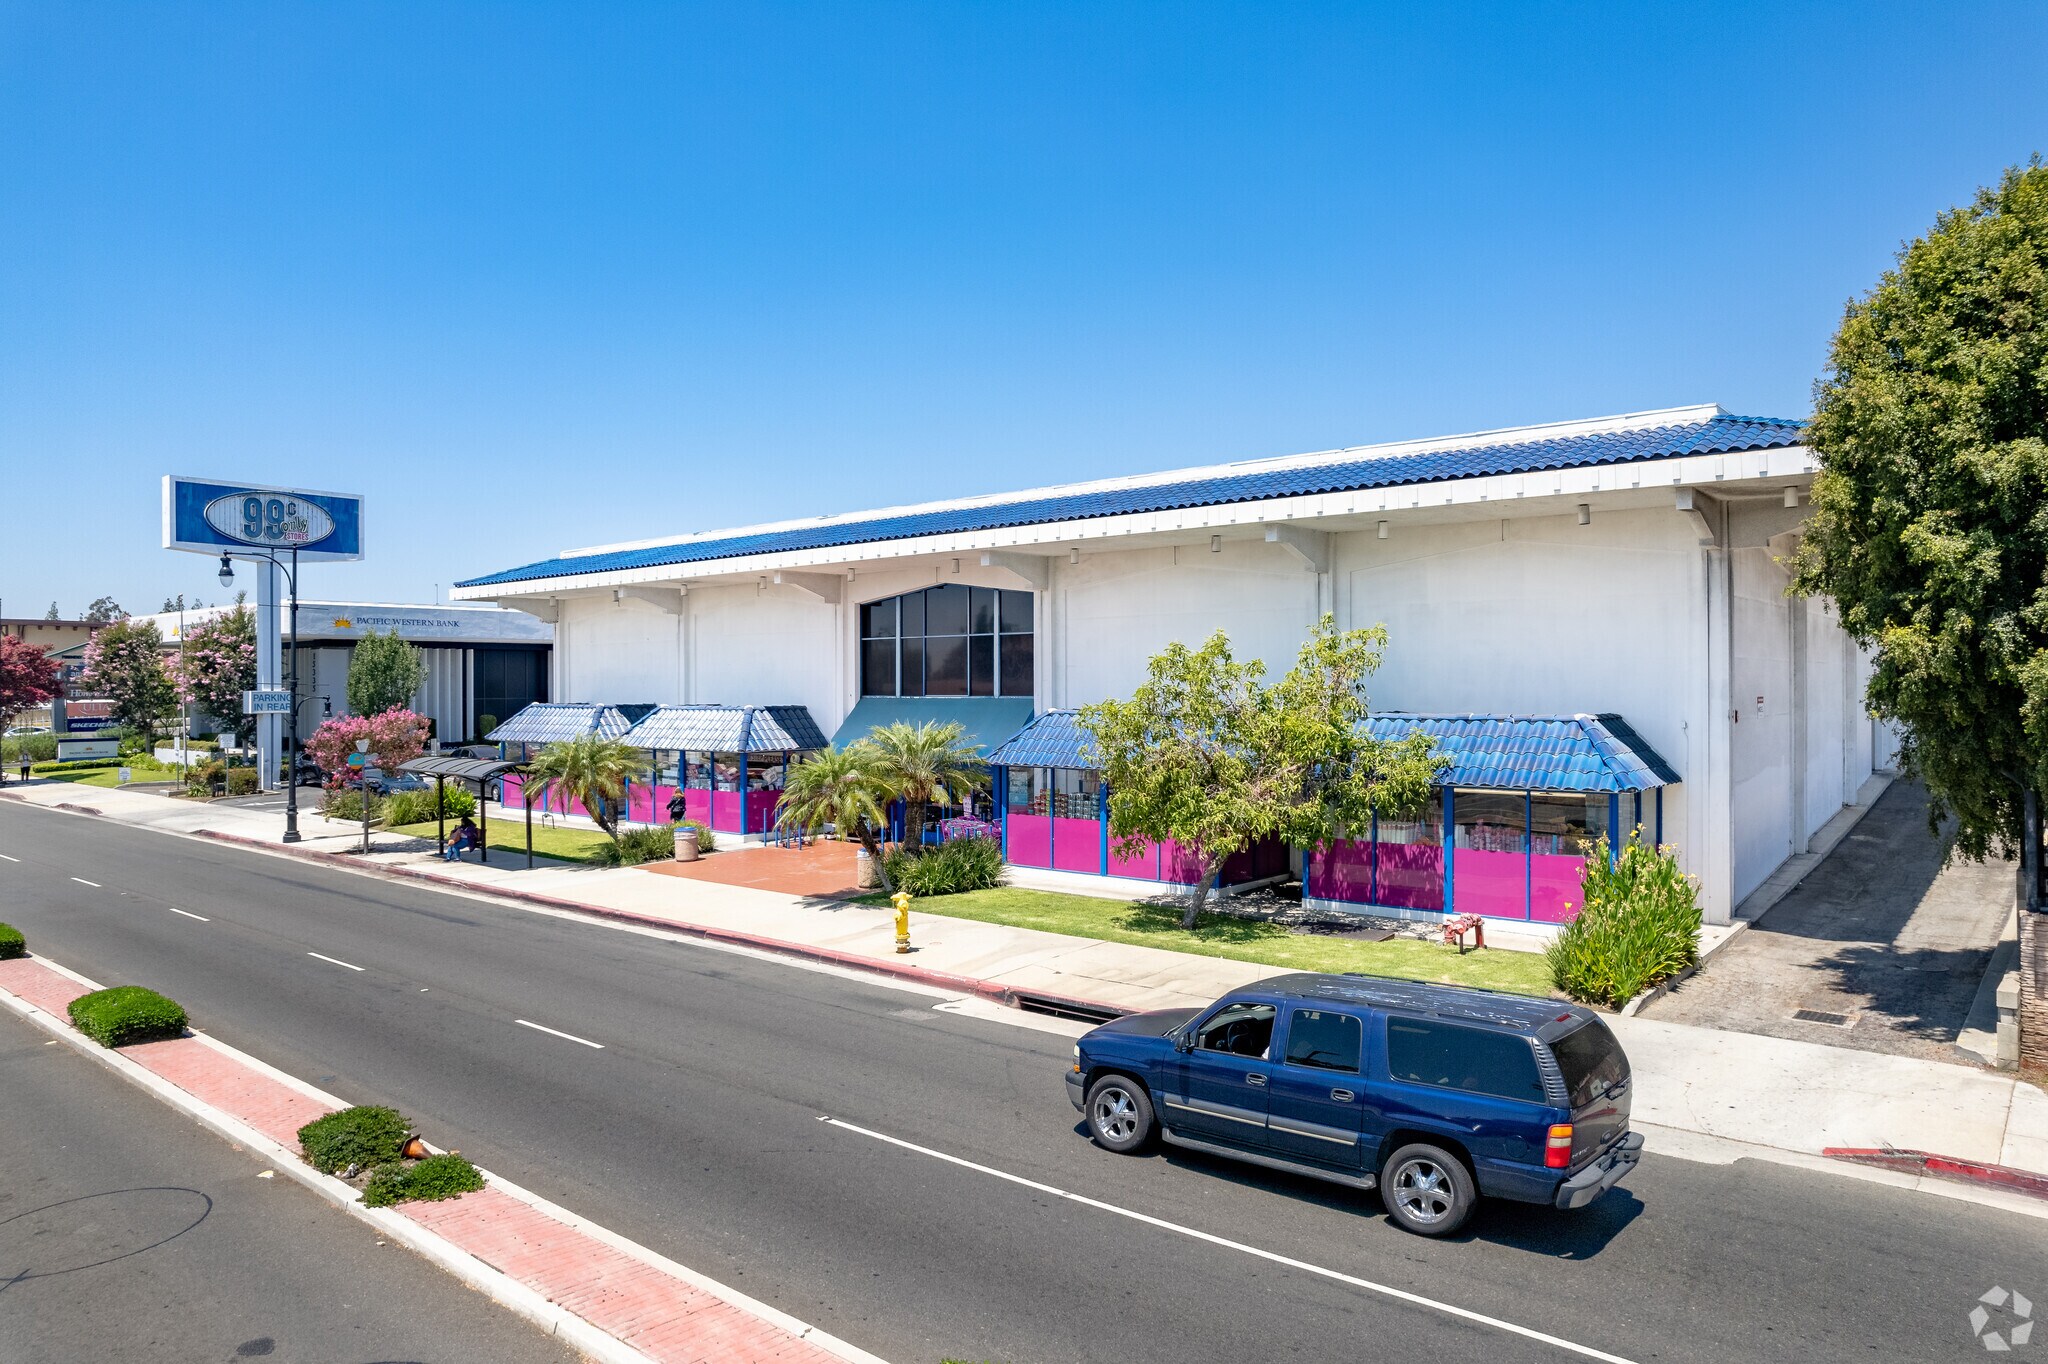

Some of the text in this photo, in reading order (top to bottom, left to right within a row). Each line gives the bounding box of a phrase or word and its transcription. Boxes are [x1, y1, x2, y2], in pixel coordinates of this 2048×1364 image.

[280, 516, 308, 532] only
[286, 532, 310, 541] STORES
[356, 617, 460, 628] PACIFIC WESTERN BANK
[253, 703, 263, 711] IN
